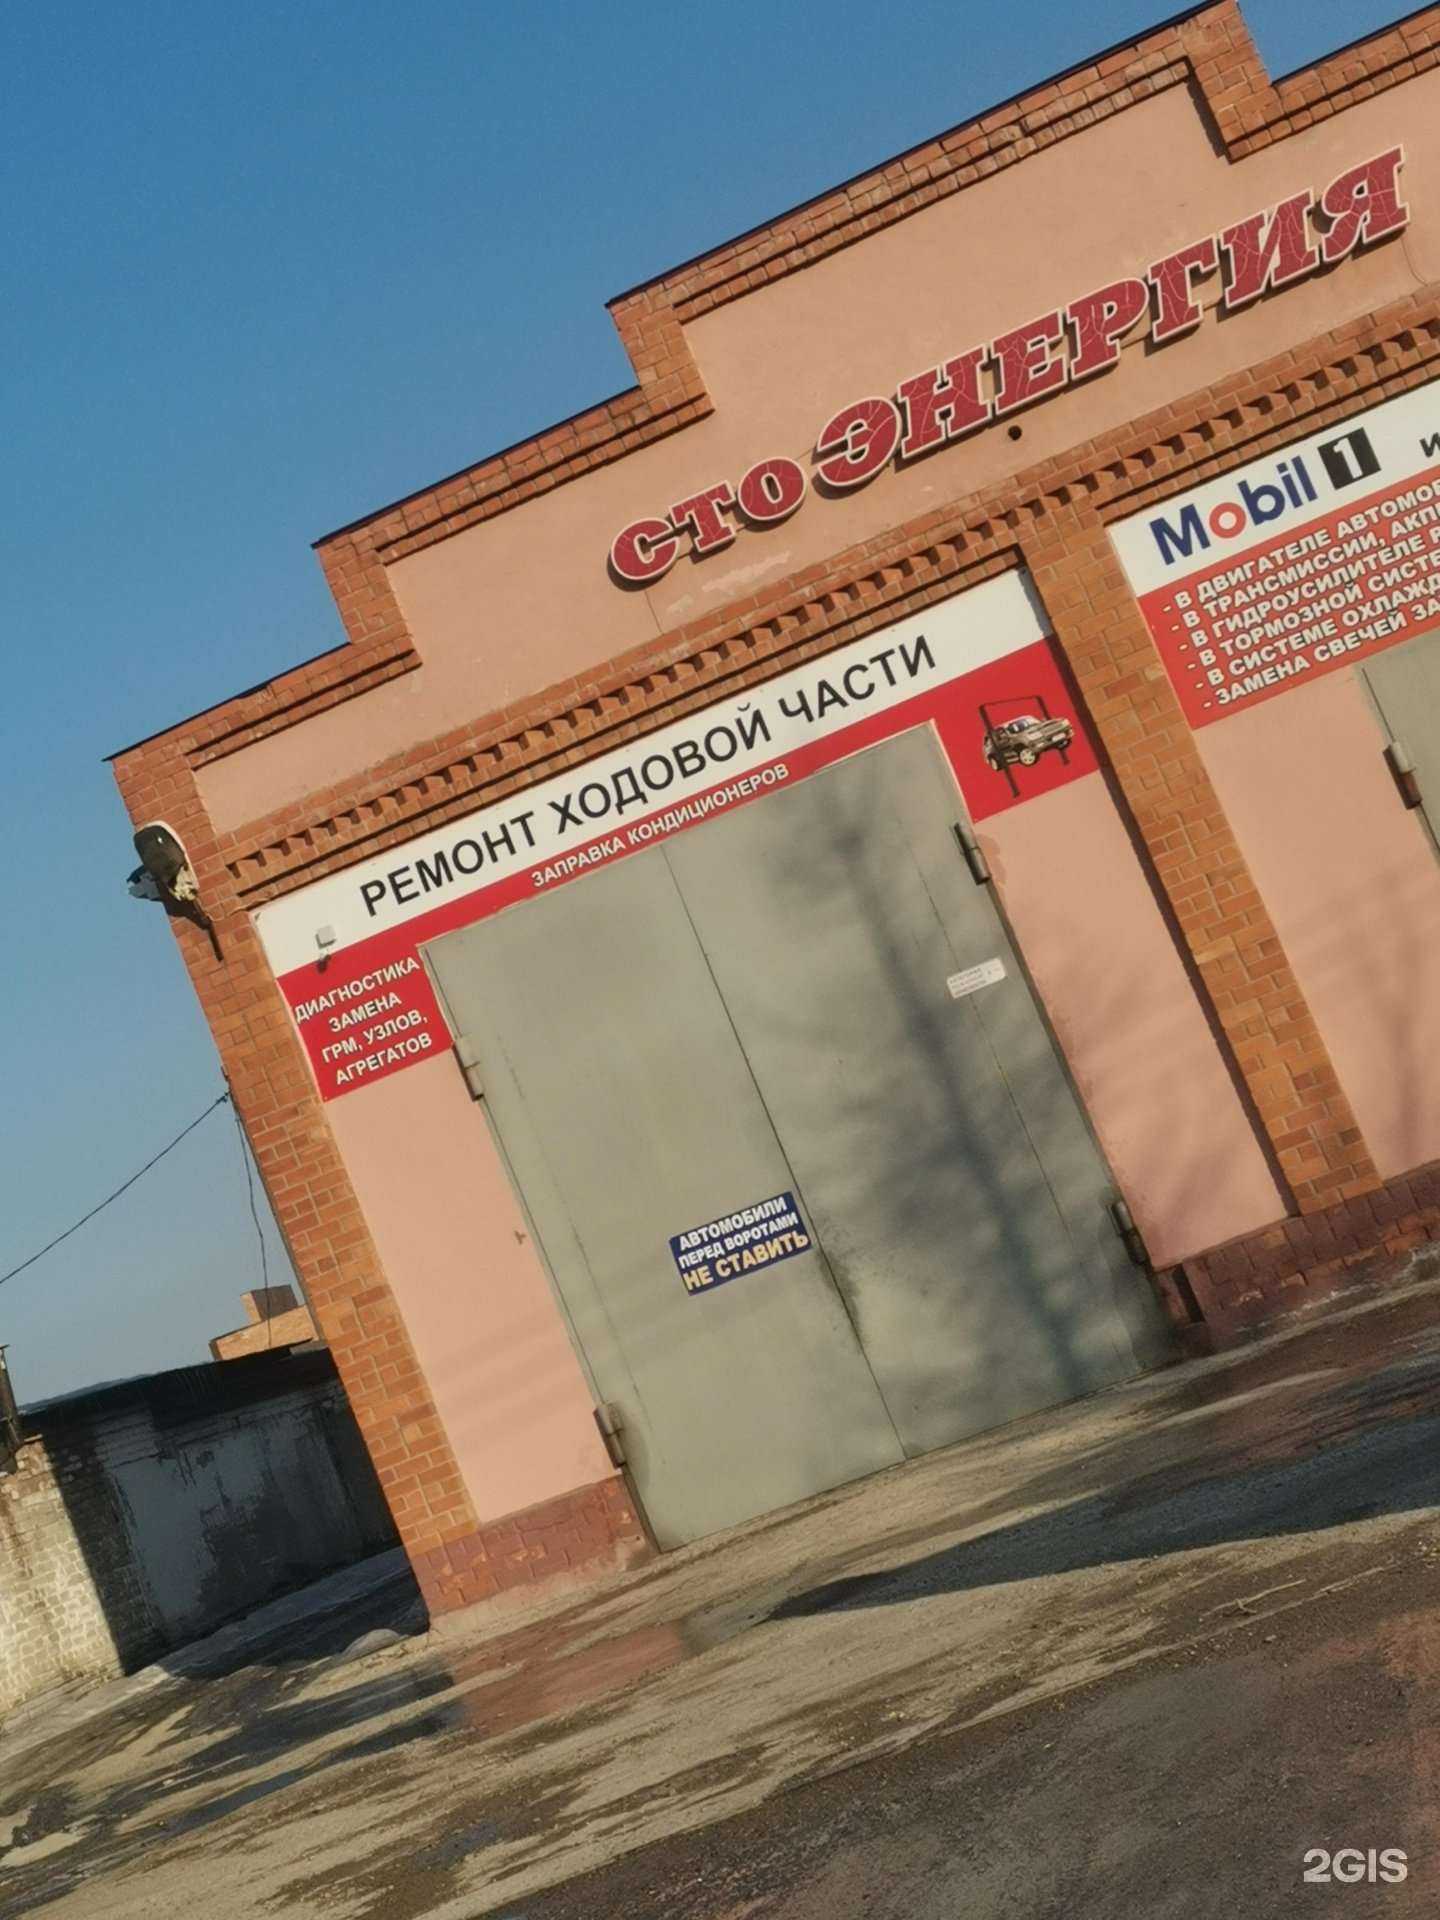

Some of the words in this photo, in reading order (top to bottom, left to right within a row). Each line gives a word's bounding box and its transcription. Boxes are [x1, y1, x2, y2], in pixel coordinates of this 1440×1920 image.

[608, 456, 806, 581] СТО
[816, 145, 1411, 488] ЭНЕРГИЯ
[1150, 455, 1318, 565] Mobil
[1174, 591, 1192, 609] В
[1197, 528, 1331, 603] ДВИГАТЕЛЕ
[1182, 610, 1200, 628] В
[1203, 531, 1386, 618] ТРАНСМИССИИ,
[1391, 503, 1440, 539] АКП
[1191, 629, 1208, 647] В
[1212, 534, 1426, 638] ГИДРОУСИЛИТЕЛЕ
[1199, 648, 1217, 666] В
[1219, 582, 1364, 656] ТОРМОЗНОЙ
[1207, 667, 1225, 686] В
[1228, 618, 1338, 676] СИСТЕМЕ
[1215, 655, 1310, 705] ЗАМЕНА
[1314, 610, 1407, 662] СВЕЧЕЙ
[359, 811, 539, 917] РЕМОНТ
[550, 702, 772, 833] ХОДОВОЙ
[779, 635, 936, 723] ЧАСТИ
[531, 836, 626, 888] ЗАПРАВКА
[628, 763, 790, 846] КОНДИЦИОНЕРОВ
[294, 956, 420, 1024] ДИАГНОСТИКА
[329, 992, 402, 1032] ЗАМЕНА
[322, 1037, 363, 1063] ГРМ,
[363, 1009, 428, 1045] УЗЛОВ,
[336, 1032, 432, 1085] АГРЕГАТОВ
[678, 1243, 725, 1269] ПЕРЕД
[725, 1212, 798, 1251] ВОРОТАМИ
[679, 1196, 787, 1250] АВТОМОБИЛИ
[683, 1266, 714, 1290] НЕ
[715, 1231, 808, 1278] СТАВИТЬ
